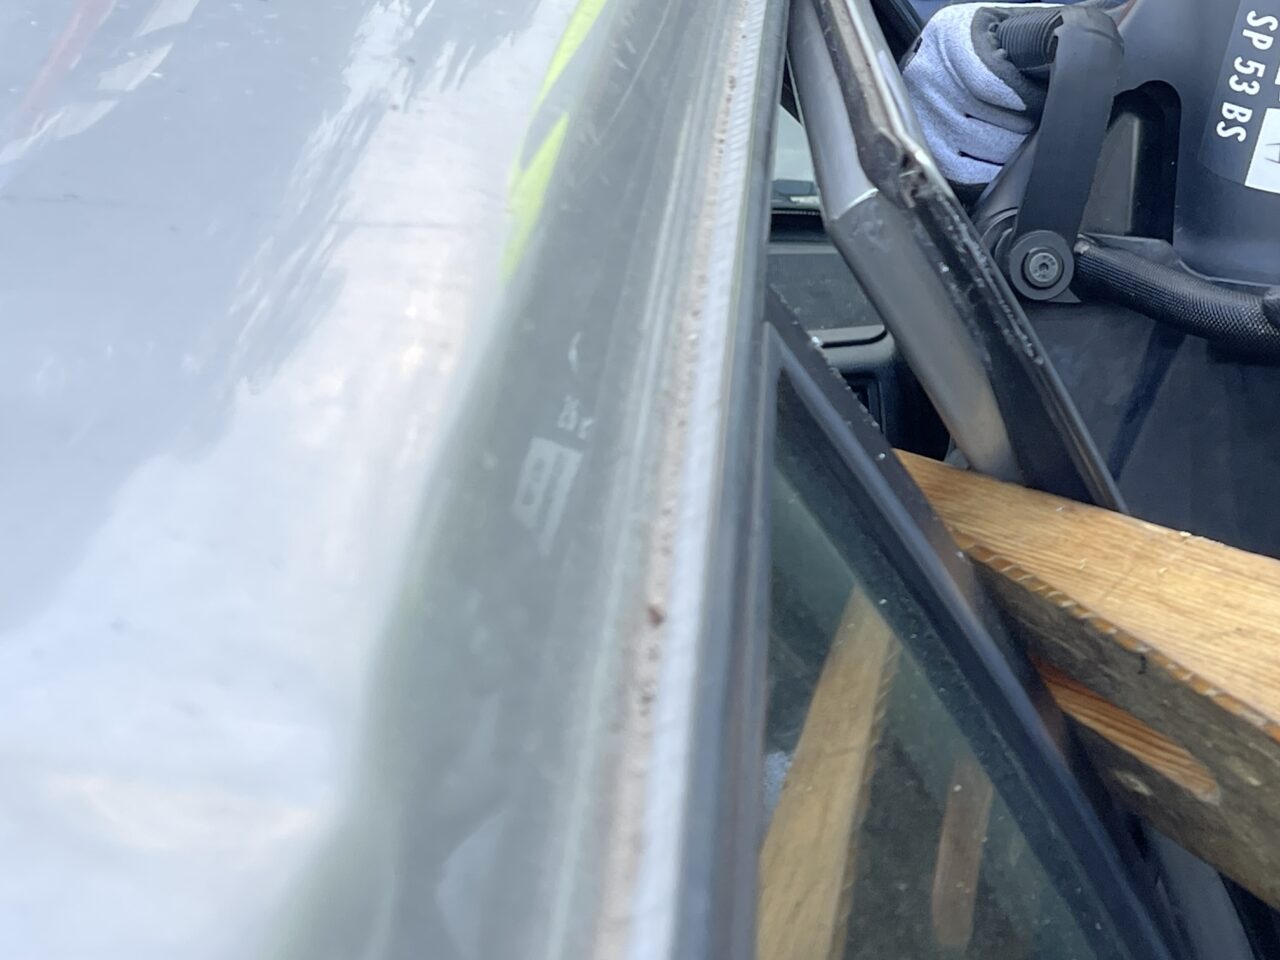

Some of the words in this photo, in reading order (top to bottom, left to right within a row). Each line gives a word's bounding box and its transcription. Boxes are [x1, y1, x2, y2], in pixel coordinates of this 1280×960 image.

[1242, 10, 1279, 51] SP
[1228, 56, 1266, 96] 53
[1216, 101, 1253, 142] BS
